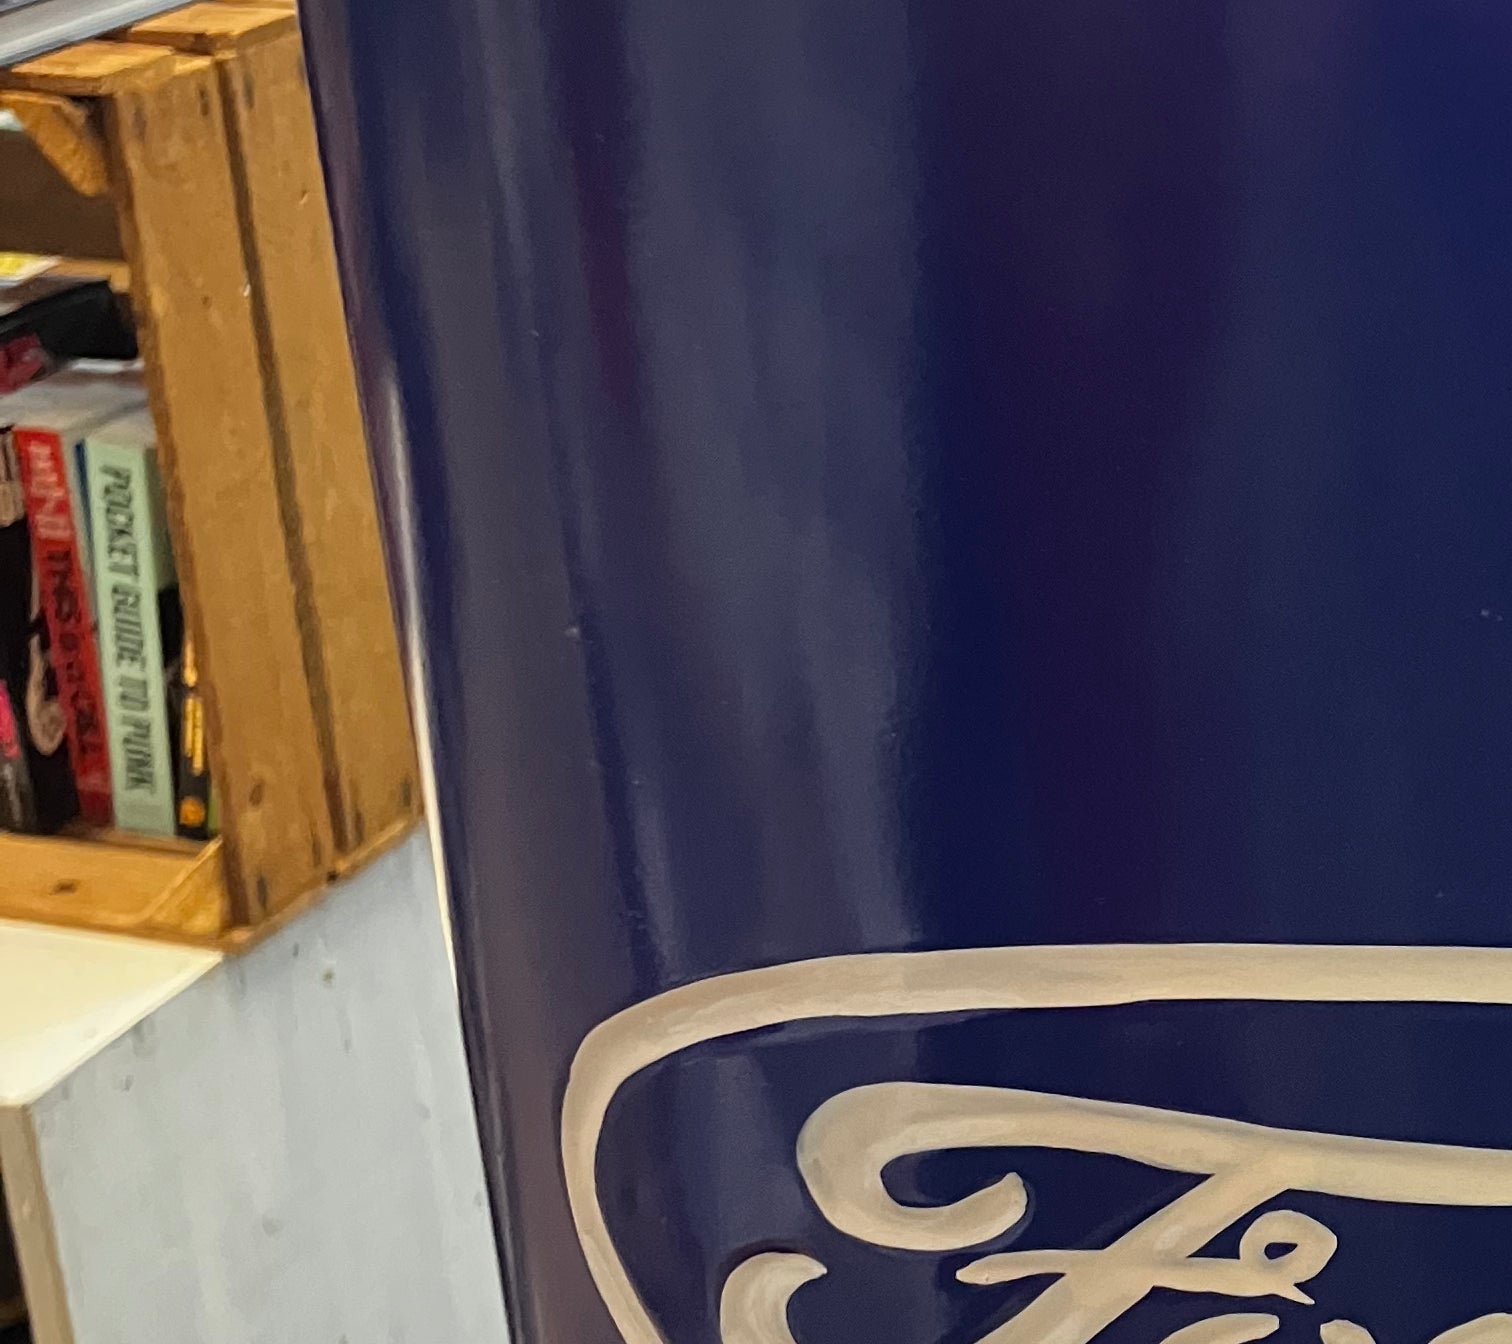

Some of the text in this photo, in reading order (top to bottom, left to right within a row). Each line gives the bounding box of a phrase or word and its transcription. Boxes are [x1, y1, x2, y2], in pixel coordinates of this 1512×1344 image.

[102, 463, 154, 794] POCKET GUIDE TO PUNK
